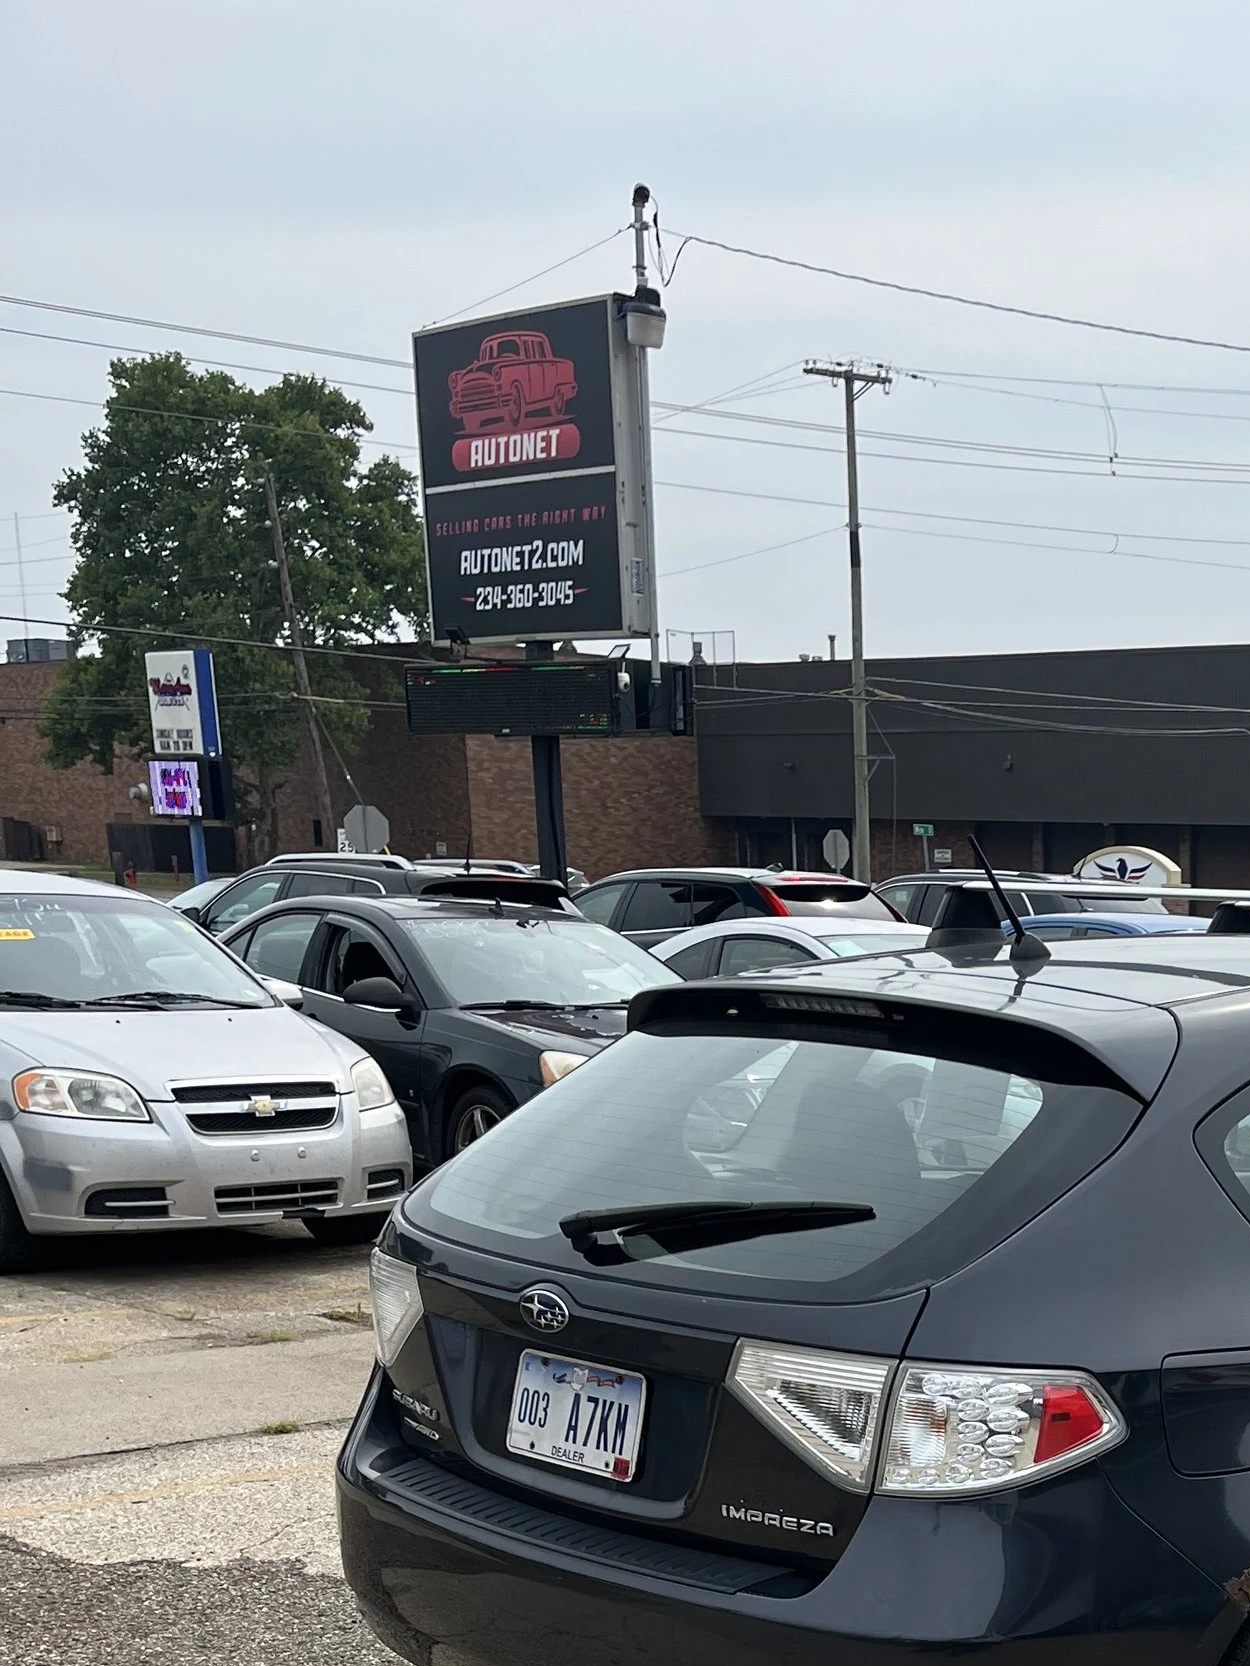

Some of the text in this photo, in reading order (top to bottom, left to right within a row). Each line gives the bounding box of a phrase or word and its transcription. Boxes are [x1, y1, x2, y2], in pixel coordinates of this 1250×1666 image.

[470, 428, 560, 468] AUTONET
[436, 505, 607, 536] SELLING CARS THE RIGHT WAY
[460, 539, 584, 575] AUTONET2.COM
[476, 580, 574, 610] 234-360-3045
[340, 842, 354, 853] 25
[518, 1387, 629, 1456] 003 A7KM
[551, 1445, 585, 1463] DEALER
[721, 1504, 834, 1537] IMPREZA
